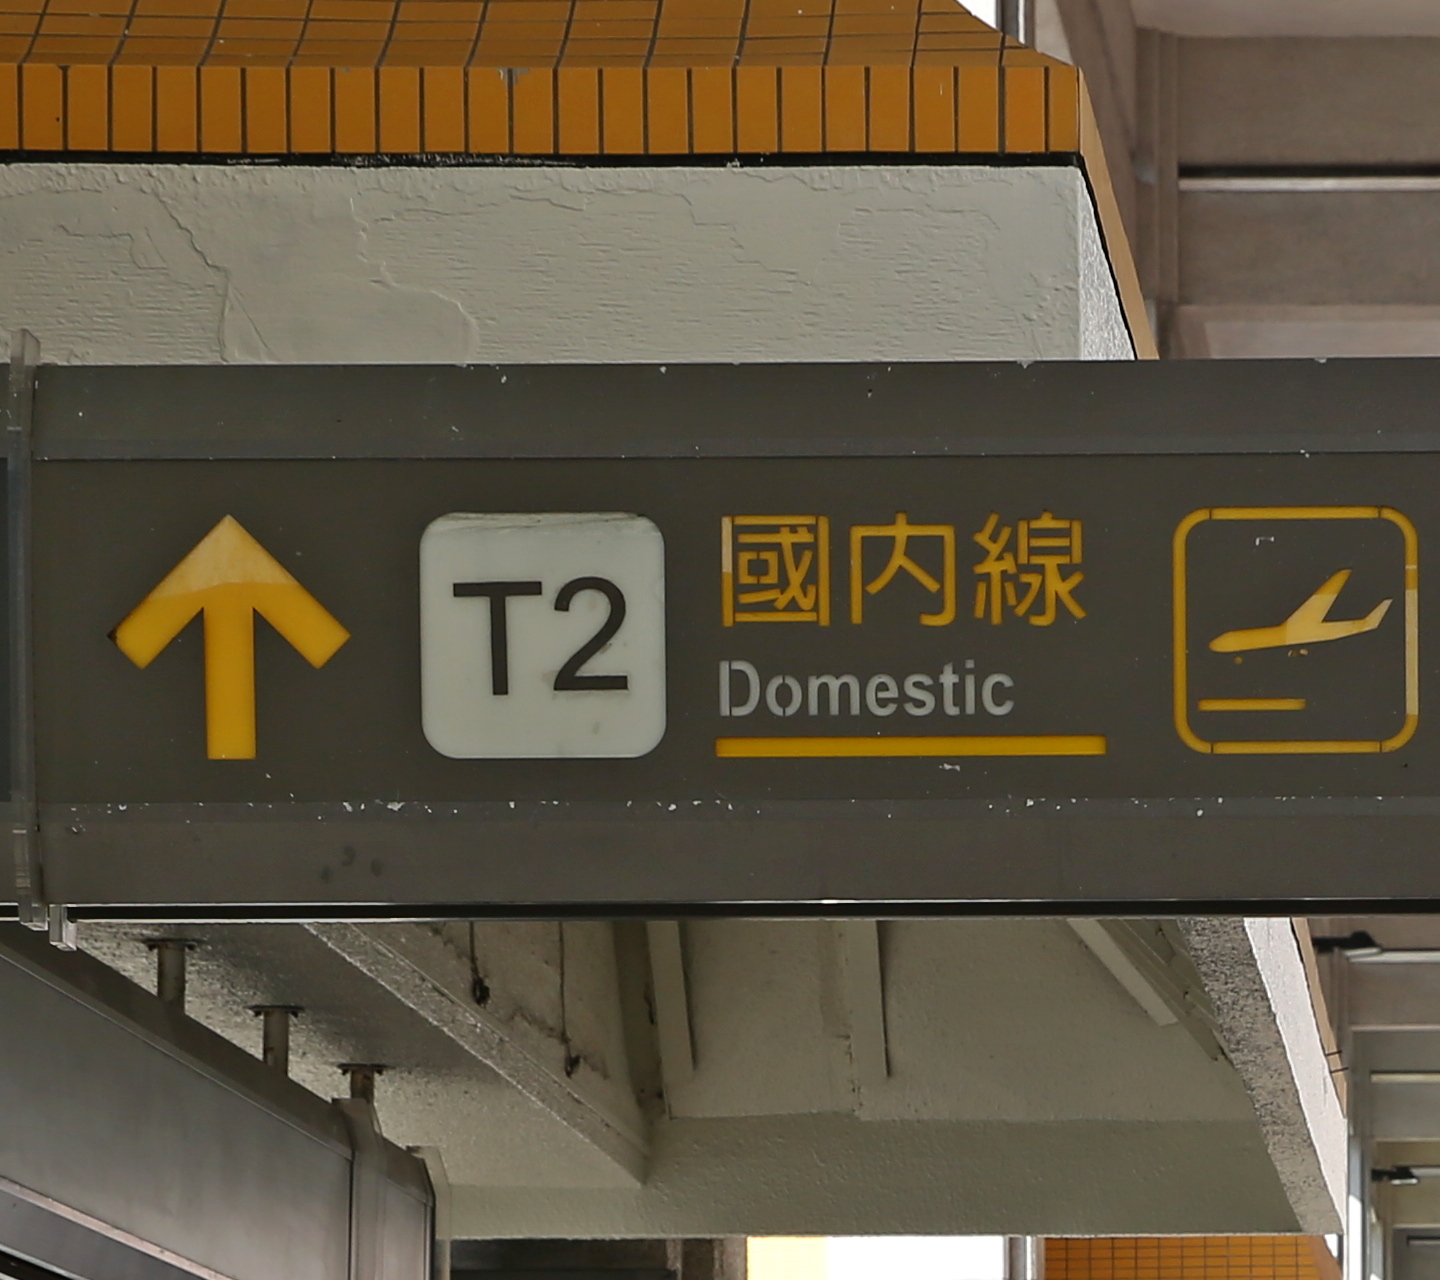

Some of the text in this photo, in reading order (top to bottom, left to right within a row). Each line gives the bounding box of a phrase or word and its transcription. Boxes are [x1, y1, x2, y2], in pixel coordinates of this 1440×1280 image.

[719, 512, 1088, 630] 國內線
[449, 574, 632, 698] T2
[717, 658, 1016, 720] Domestic
